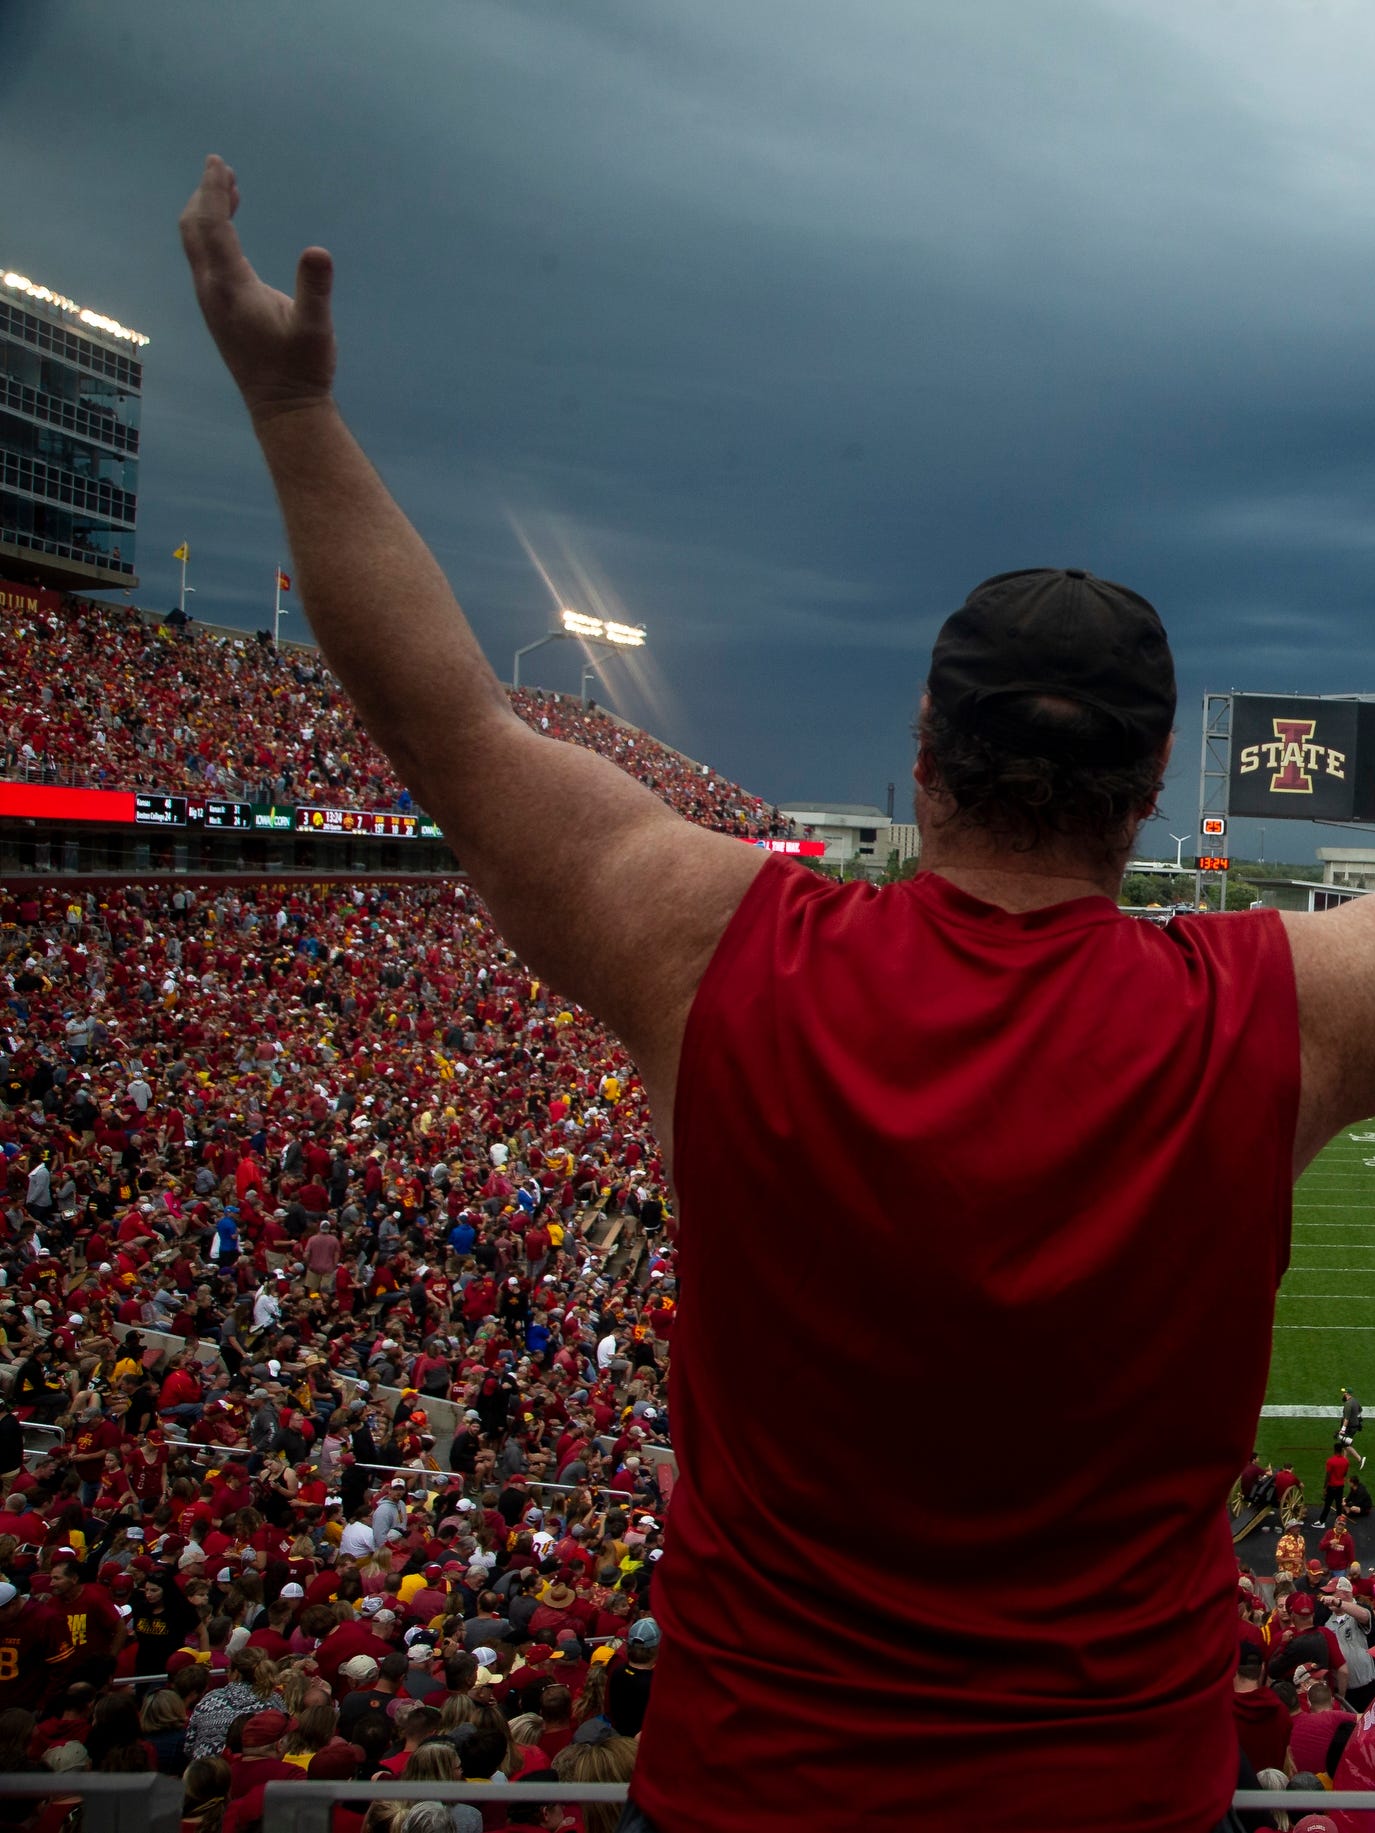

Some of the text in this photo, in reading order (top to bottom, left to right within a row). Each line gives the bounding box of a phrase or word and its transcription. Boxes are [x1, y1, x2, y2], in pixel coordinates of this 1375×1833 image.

[1240, 742, 1345, 779] STATE
[189, 806, 204, 819] Big 12
[303, 812, 309, 825] 3
[358, 816, 362, 828] 7
[1200, 858, 1228, 869] 13:24
